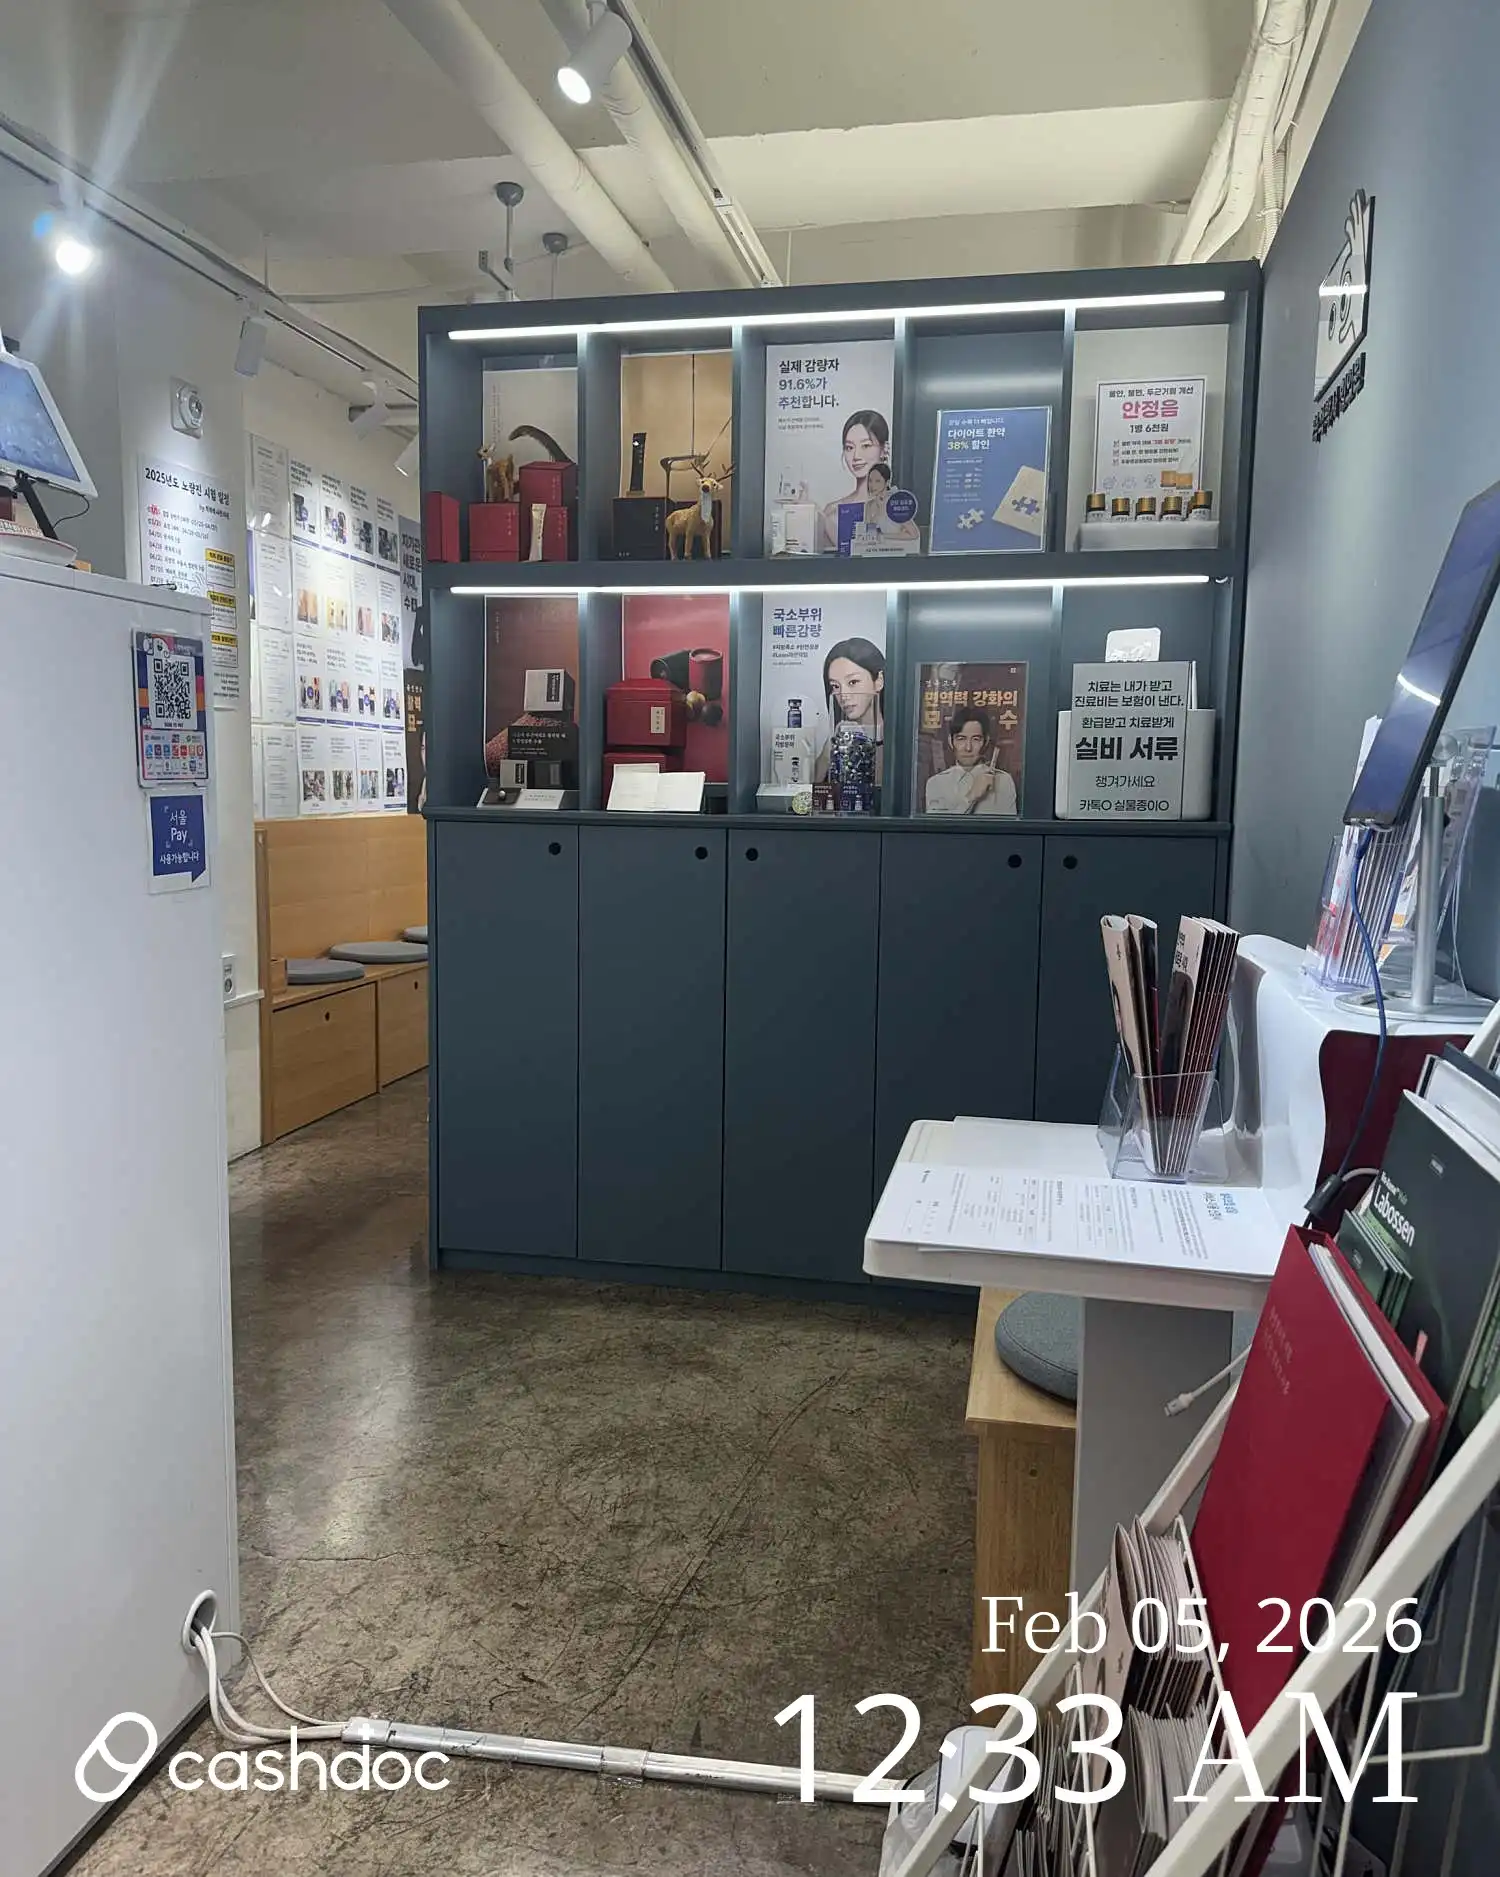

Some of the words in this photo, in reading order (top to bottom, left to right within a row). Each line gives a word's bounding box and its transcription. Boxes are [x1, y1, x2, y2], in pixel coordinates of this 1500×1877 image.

[779, 359, 802, 374] 실제
[804, 358, 840, 373] 감량자
[779, 377, 828, 390] 91.6%가
[778, 394, 840, 409] 추천합니다.
[1122, 399, 1179, 420] 안정음
[947, 428, 984, 439] 다이어트
[987, 427, 1006, 438] 한약
[1145, 423, 1169, 433] 6천원
[947, 440, 969, 450] 38%
[145, 467, 180, 488] 2025년도
[181, 481, 202, 497] 노량진
[773, 607, 822, 622] 국소부위
[773, 624, 822, 638] 빠른감량
[1088, 681, 1121, 692] 치료는
[1124, 680, 1147, 692] 내가
[1149, 680, 1173, 692] 받고
[972, 690, 1018, 707] 강화의
[1074, 696, 1118, 708] 진료비는
[1121, 696, 1155, 707] 보험이
[1158, 695, 1184, 707] 낸다.
[1082, 717, 1126, 729] 환급받고
[1129, 716, 1174, 728] 치료받게
[1075, 736, 1122, 761] 실비
[1129, 736, 1178, 761] 서류
[1095, 775, 1155, 788] 챙겨가세요
[170, 809, 188, 826] 서울
[170, 827, 188, 844] Pay
[160, 851, 200, 865] 사용가능합니다
[1373, 1184, 1415, 1248] Labossen
